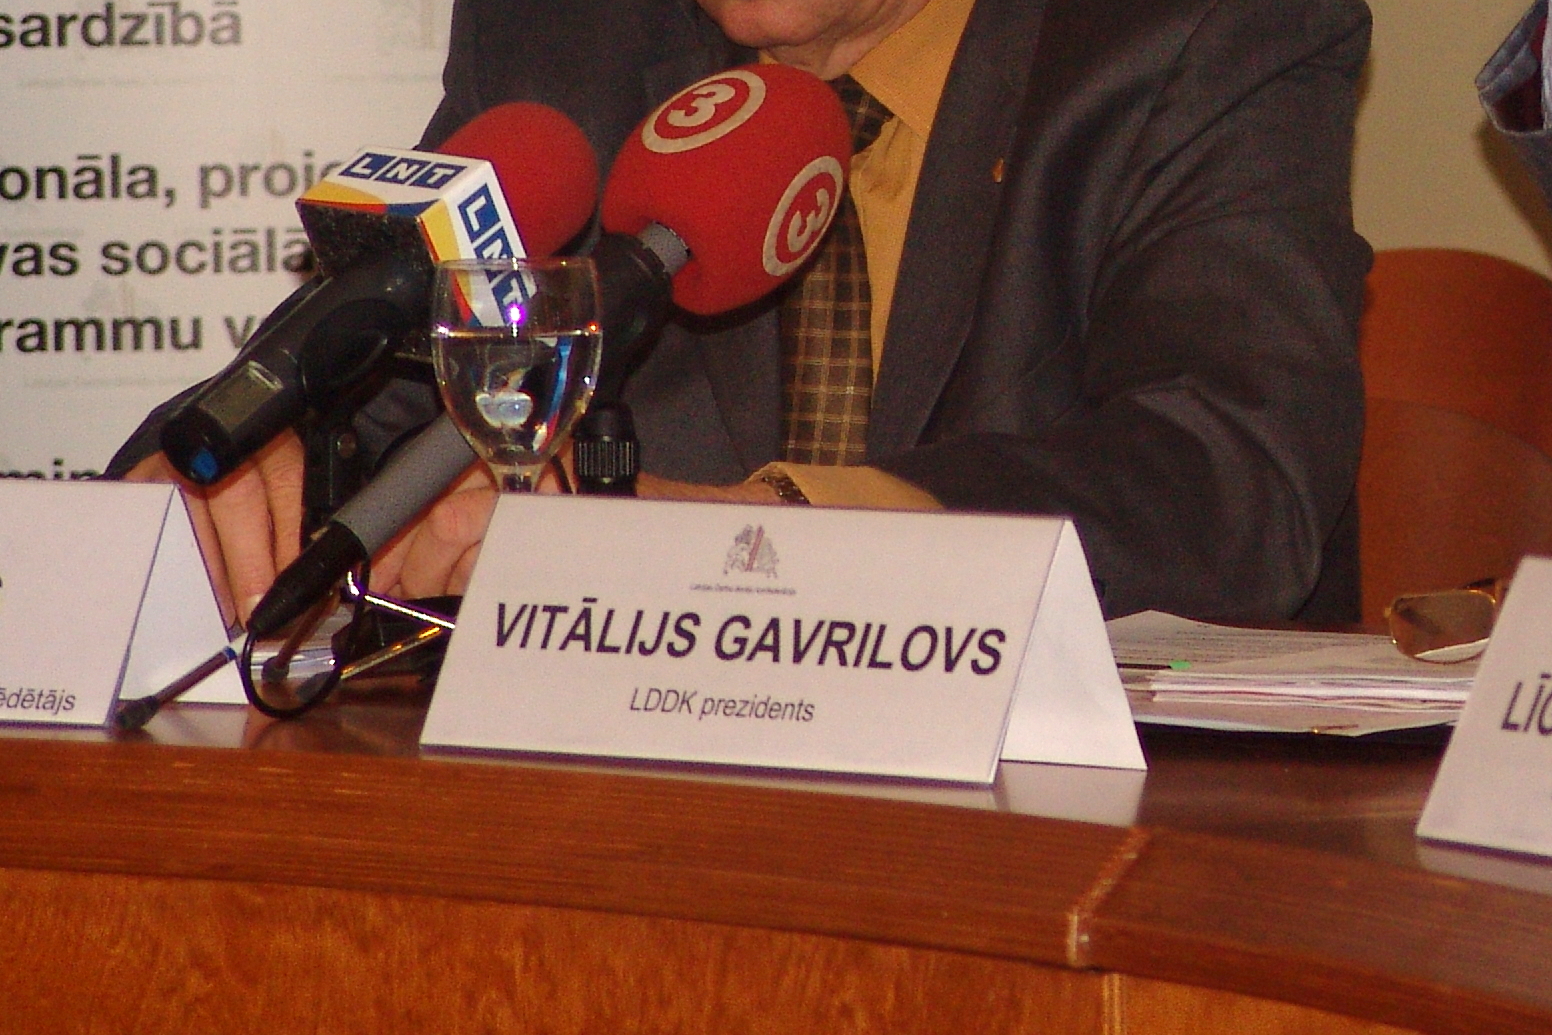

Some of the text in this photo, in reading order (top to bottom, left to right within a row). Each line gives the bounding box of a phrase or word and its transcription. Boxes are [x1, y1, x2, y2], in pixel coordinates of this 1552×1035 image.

[667, 82, 736, 127] 3
[0, 153, 177, 208] onāla,
[346, 155, 460, 186] LNT
[494, 597, 1006, 676] VITĀLIJS GAVRILOVS
[629, 688, 815, 723] LDDK prezidents
